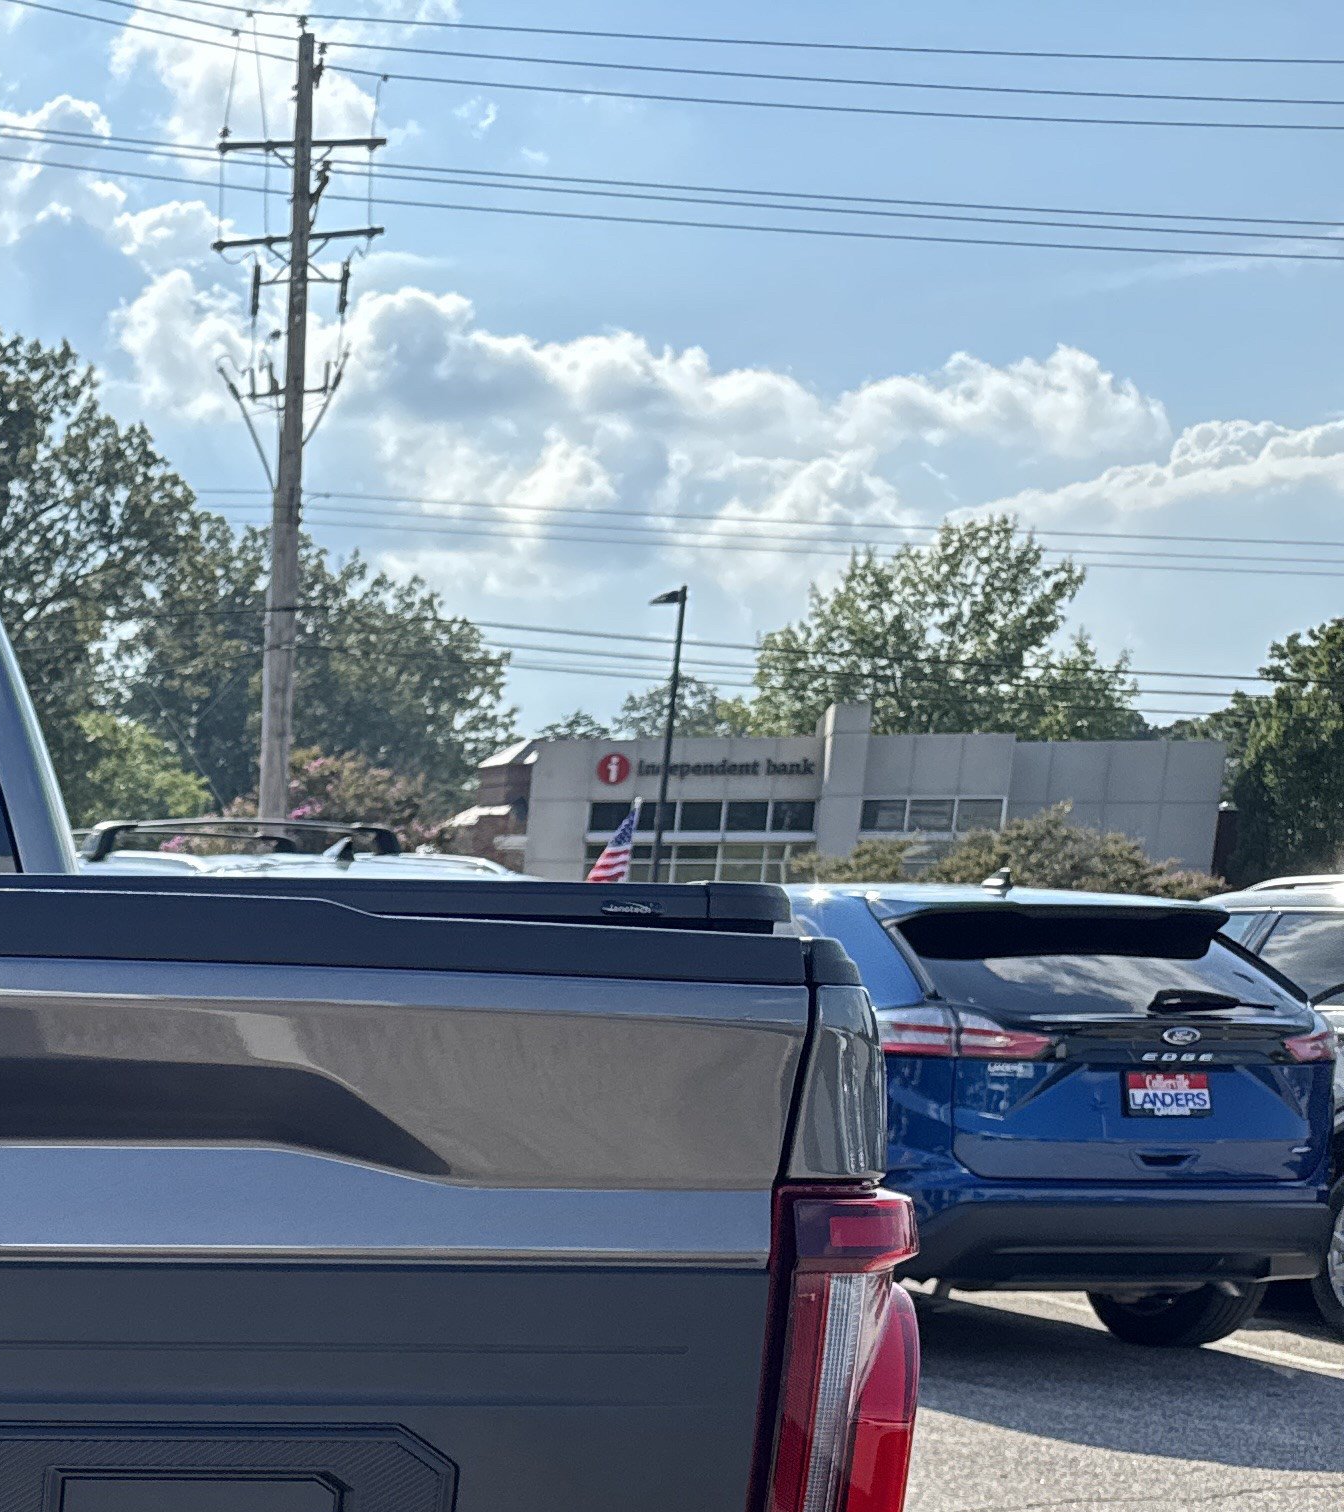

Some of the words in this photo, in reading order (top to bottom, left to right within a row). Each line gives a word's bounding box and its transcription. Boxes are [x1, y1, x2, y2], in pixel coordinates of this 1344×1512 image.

[637, 757, 760, 778] Inependent
[765, 757, 815, 776] bank
[1141, 1052, 1214, 1062] EDGE
[1131, 1092, 1208, 1109] LANDERS
